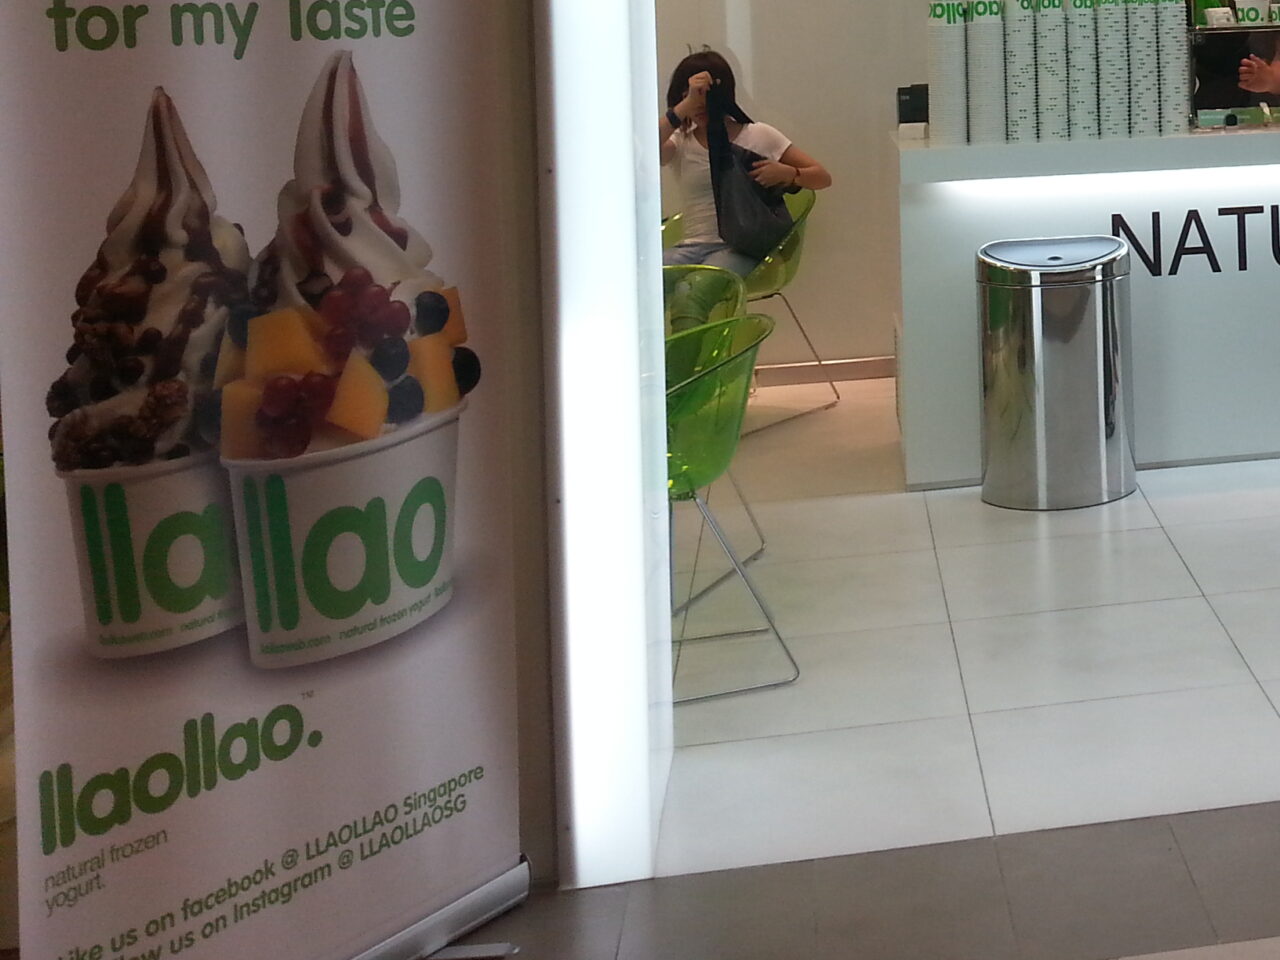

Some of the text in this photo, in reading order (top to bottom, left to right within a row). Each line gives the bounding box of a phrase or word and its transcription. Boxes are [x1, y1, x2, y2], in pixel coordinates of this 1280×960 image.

[170, 0, 259, 61] my
[242, 473, 447, 633] llao
[38, 704, 323, 856] llaollao.
[45, 829, 169, 892] natural frozen
[58, 943, 103, 960] ike
[110, 927, 138, 953] us
[145, 911, 175, 937] on
[181, 859, 276, 921] facebook
[281, 849, 299, 870] @
[305, 803, 398, 861] LLAOLLAO
[402, 766, 484, 815] Singapore
[170, 930, 195, 955] us
[201, 913, 226, 939] on
[234, 862, 332, 924] Instagram
[337, 849, 353, 870] @
[360, 793, 467, 861] LLAOLLAOSG
